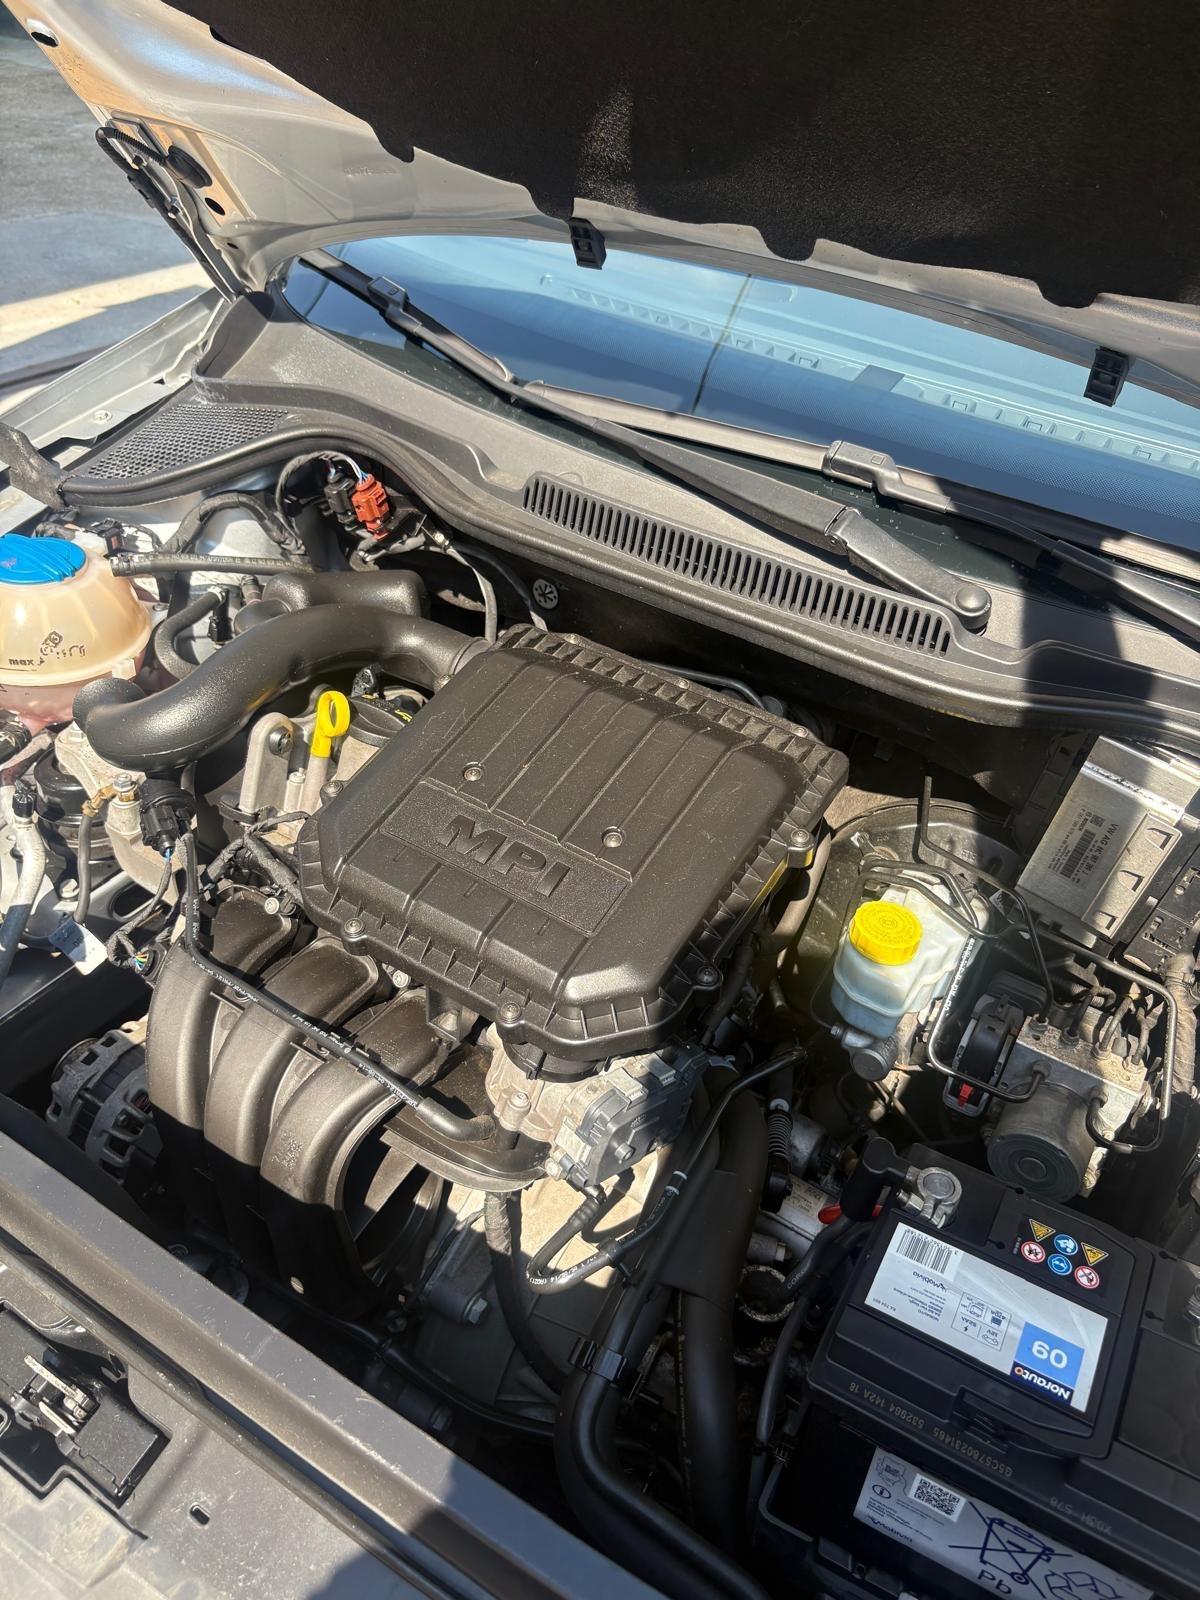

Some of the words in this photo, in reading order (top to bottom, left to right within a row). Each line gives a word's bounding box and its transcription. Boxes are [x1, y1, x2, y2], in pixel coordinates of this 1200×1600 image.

[8, 658, 34, 666] max
[436, 814, 571, 897] MPI
[912, 1271, 942, 1288] Mobivia
[1031, 1341, 1068, 1368] 09
[1014, 1366, 1071, 1400] Norauto
[978, 1569, 1012, 1595] Pb
